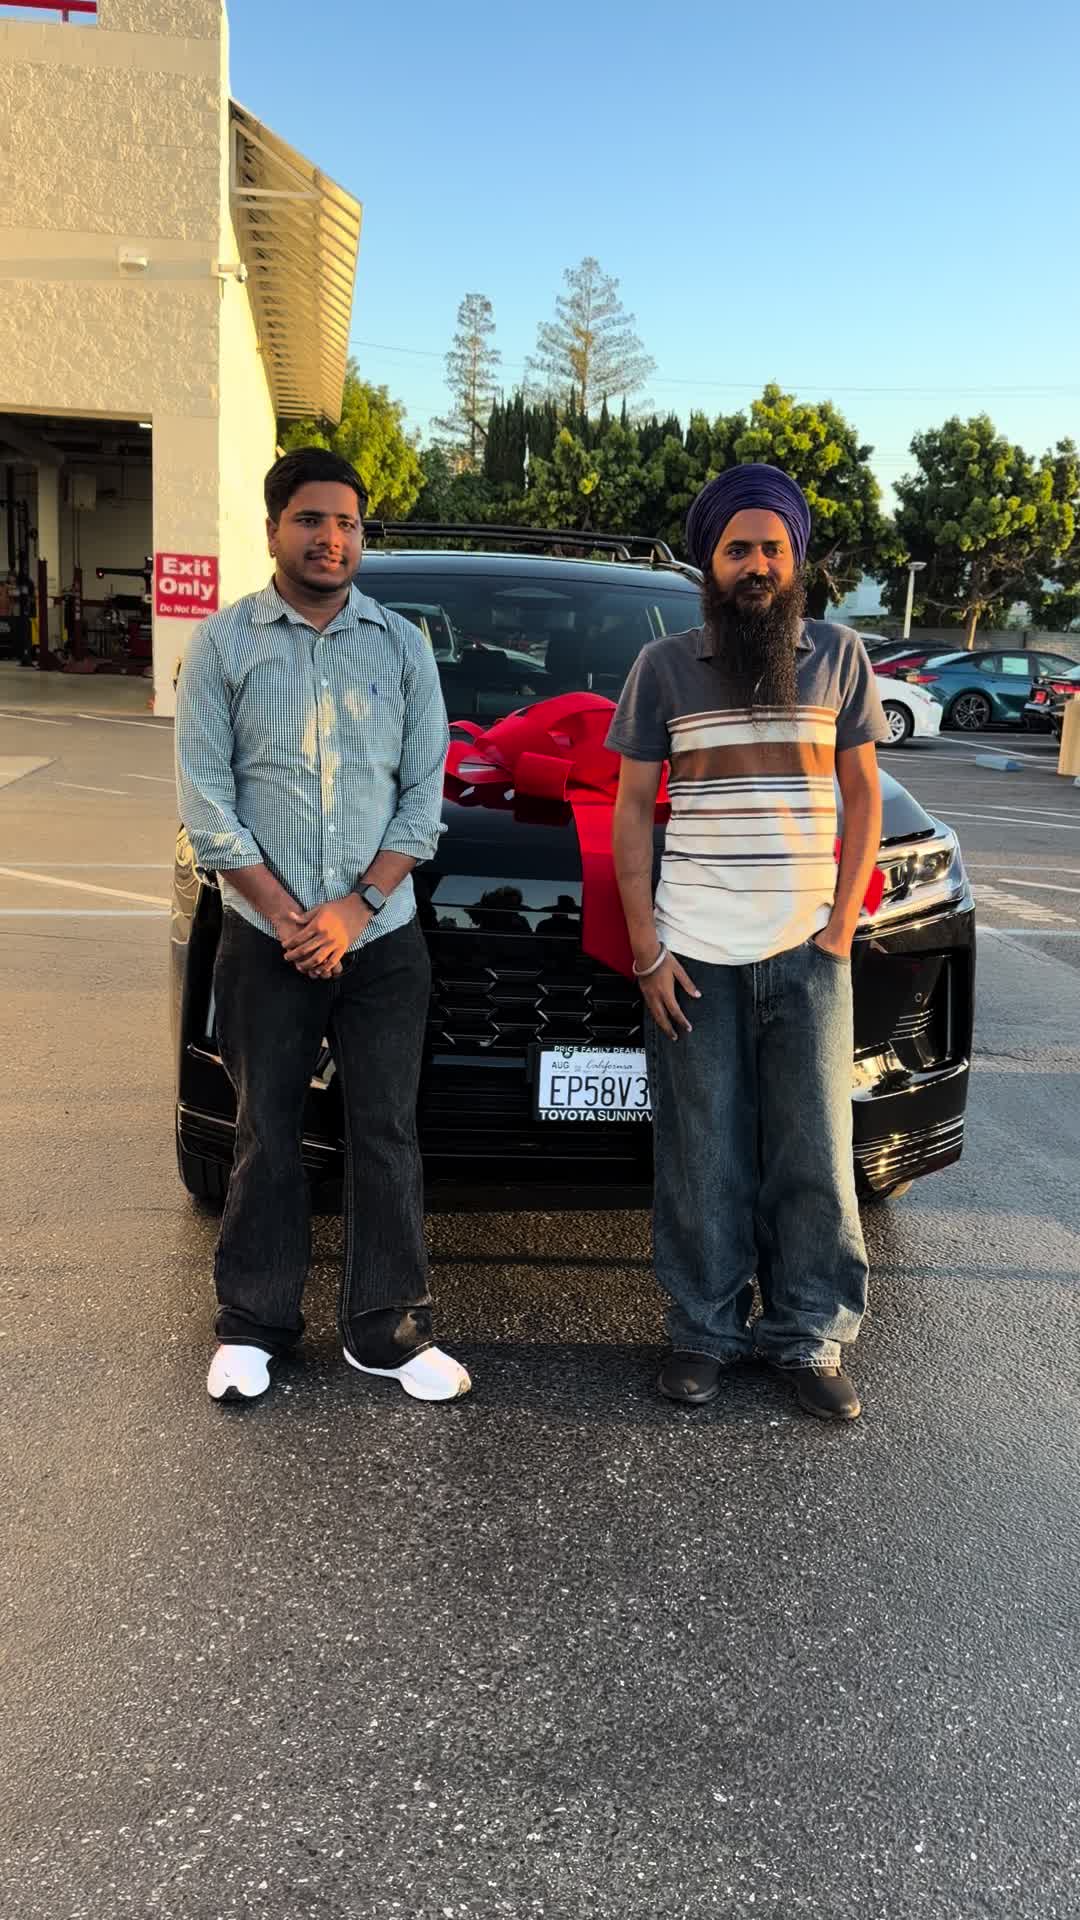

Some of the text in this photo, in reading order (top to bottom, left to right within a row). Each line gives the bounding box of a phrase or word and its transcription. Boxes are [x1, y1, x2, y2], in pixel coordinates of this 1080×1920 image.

[162, 557, 211, 576] Exit
[159, 577, 215, 601] Only
[160, 603, 172, 612] Do
[174, 605, 190, 614] Not
[581, 1046, 611, 1054] FAMILY
[552, 1061, 570, 1069] AUG
[586, 1060, 633, 1073] California
[550, 1075, 649, 1107] EP58V3
[539, 1109, 596, 1121] TOYOTA
